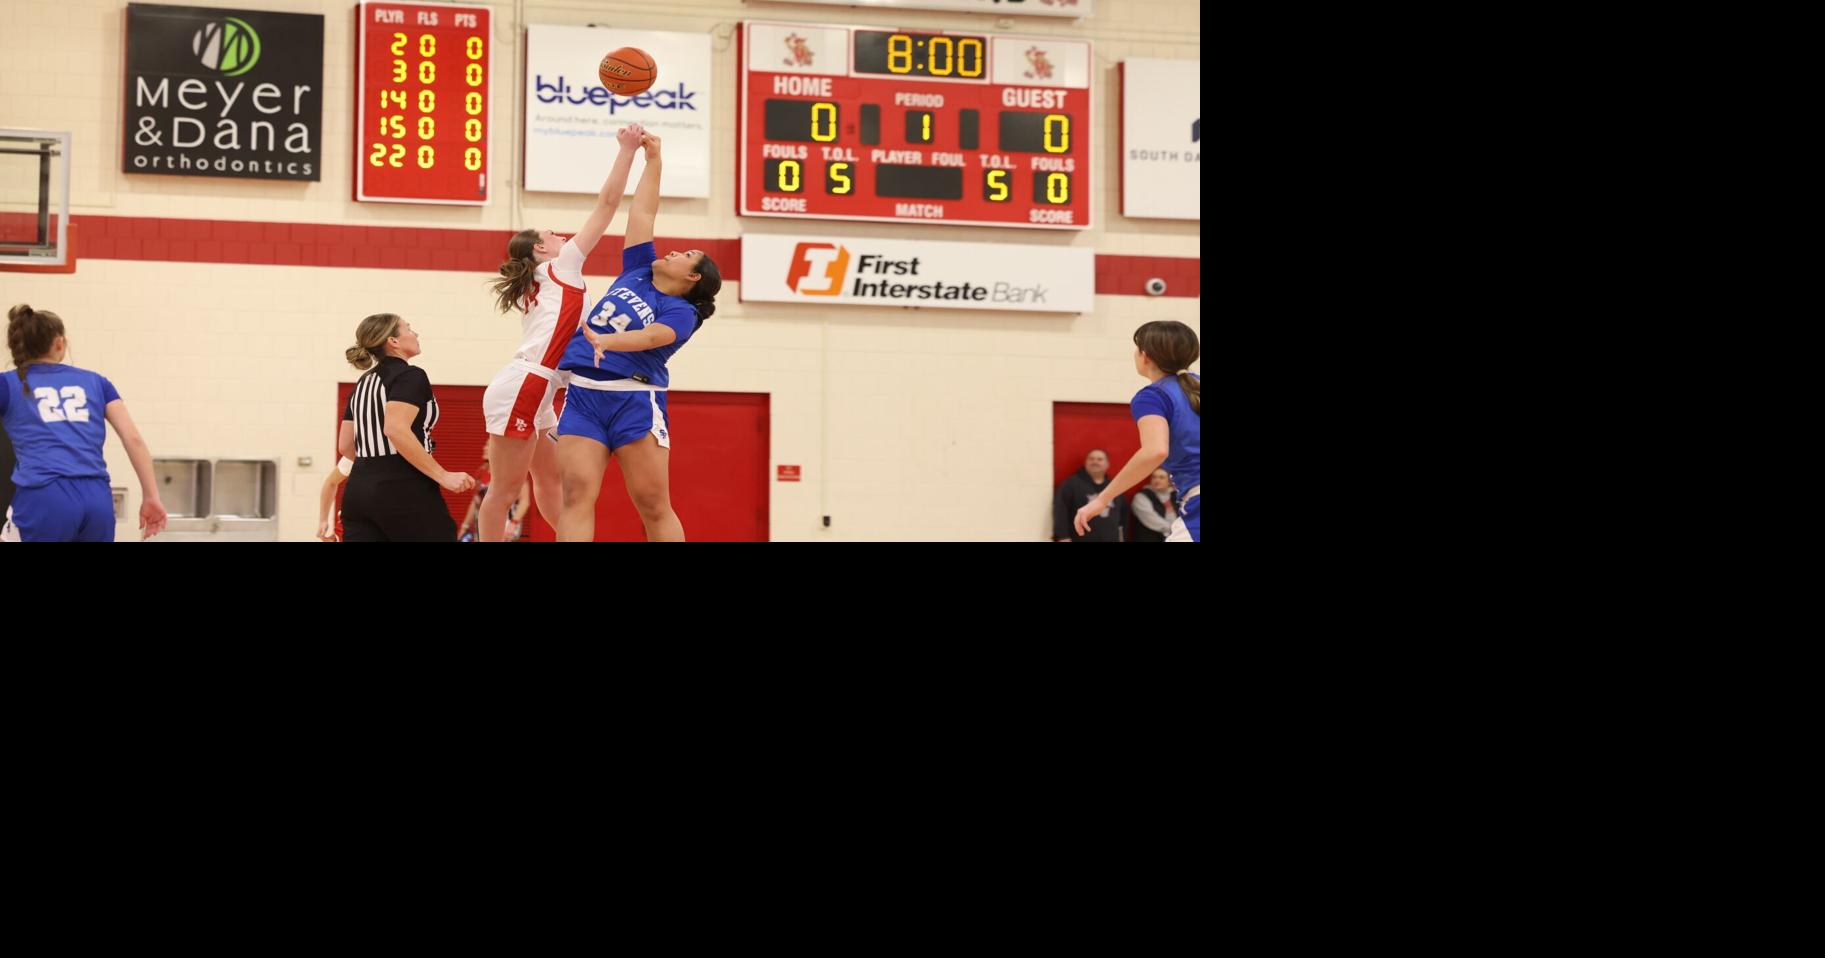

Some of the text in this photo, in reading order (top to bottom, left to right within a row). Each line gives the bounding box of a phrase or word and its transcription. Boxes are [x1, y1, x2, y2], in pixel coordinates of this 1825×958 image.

[375, 9, 477, 28] PLYR FLS PTS
[391, 33, 483, 60] 2 0 0
[888, 35, 982, 77] 8:00
[393, 60, 483, 87] 3 0 0
[135, 76, 311, 118] Meyer
[536, 75, 696, 114] bluepeak
[773, 76, 833, 98] HOME
[1002, 88, 1068, 109] GUEST
[380, 89, 482, 115] 14 0 0
[895, 93, 944, 109] PERIOD
[380, 115, 482, 142] 15 0 0
[811, 103, 837, 142] 0
[922, 114, 930, 140] 1
[1044, 114, 1069, 153] 0
[134, 154, 312, 175] orthodontics
[370, 144, 481, 171] 22 0 0
[763, 144, 808, 159] FOULS
[821, 147, 859, 162] T.O.L.
[871, 149, 966, 168] PLAYER FOUL
[980, 154, 1017, 169] T.O.L.
[1031, 157, 1075, 172] FOULS
[1130, 149, 1178, 161] SOUTH
[778, 160, 800, 192] 0
[829, 163, 851, 194] 5
[987, 170, 1008, 201] 5
[1047, 172, 1068, 204] 0
[761, 197, 807, 212] SCORE
[895, 203, 944, 218] MATCH
[1029, 209, 1073, 224] SCORE
[857, 254, 920, 276] First
[852, 277, 1048, 303] Interstate Bank
[591, 301, 633, 333] 34
[33, 385, 90, 423] 22
